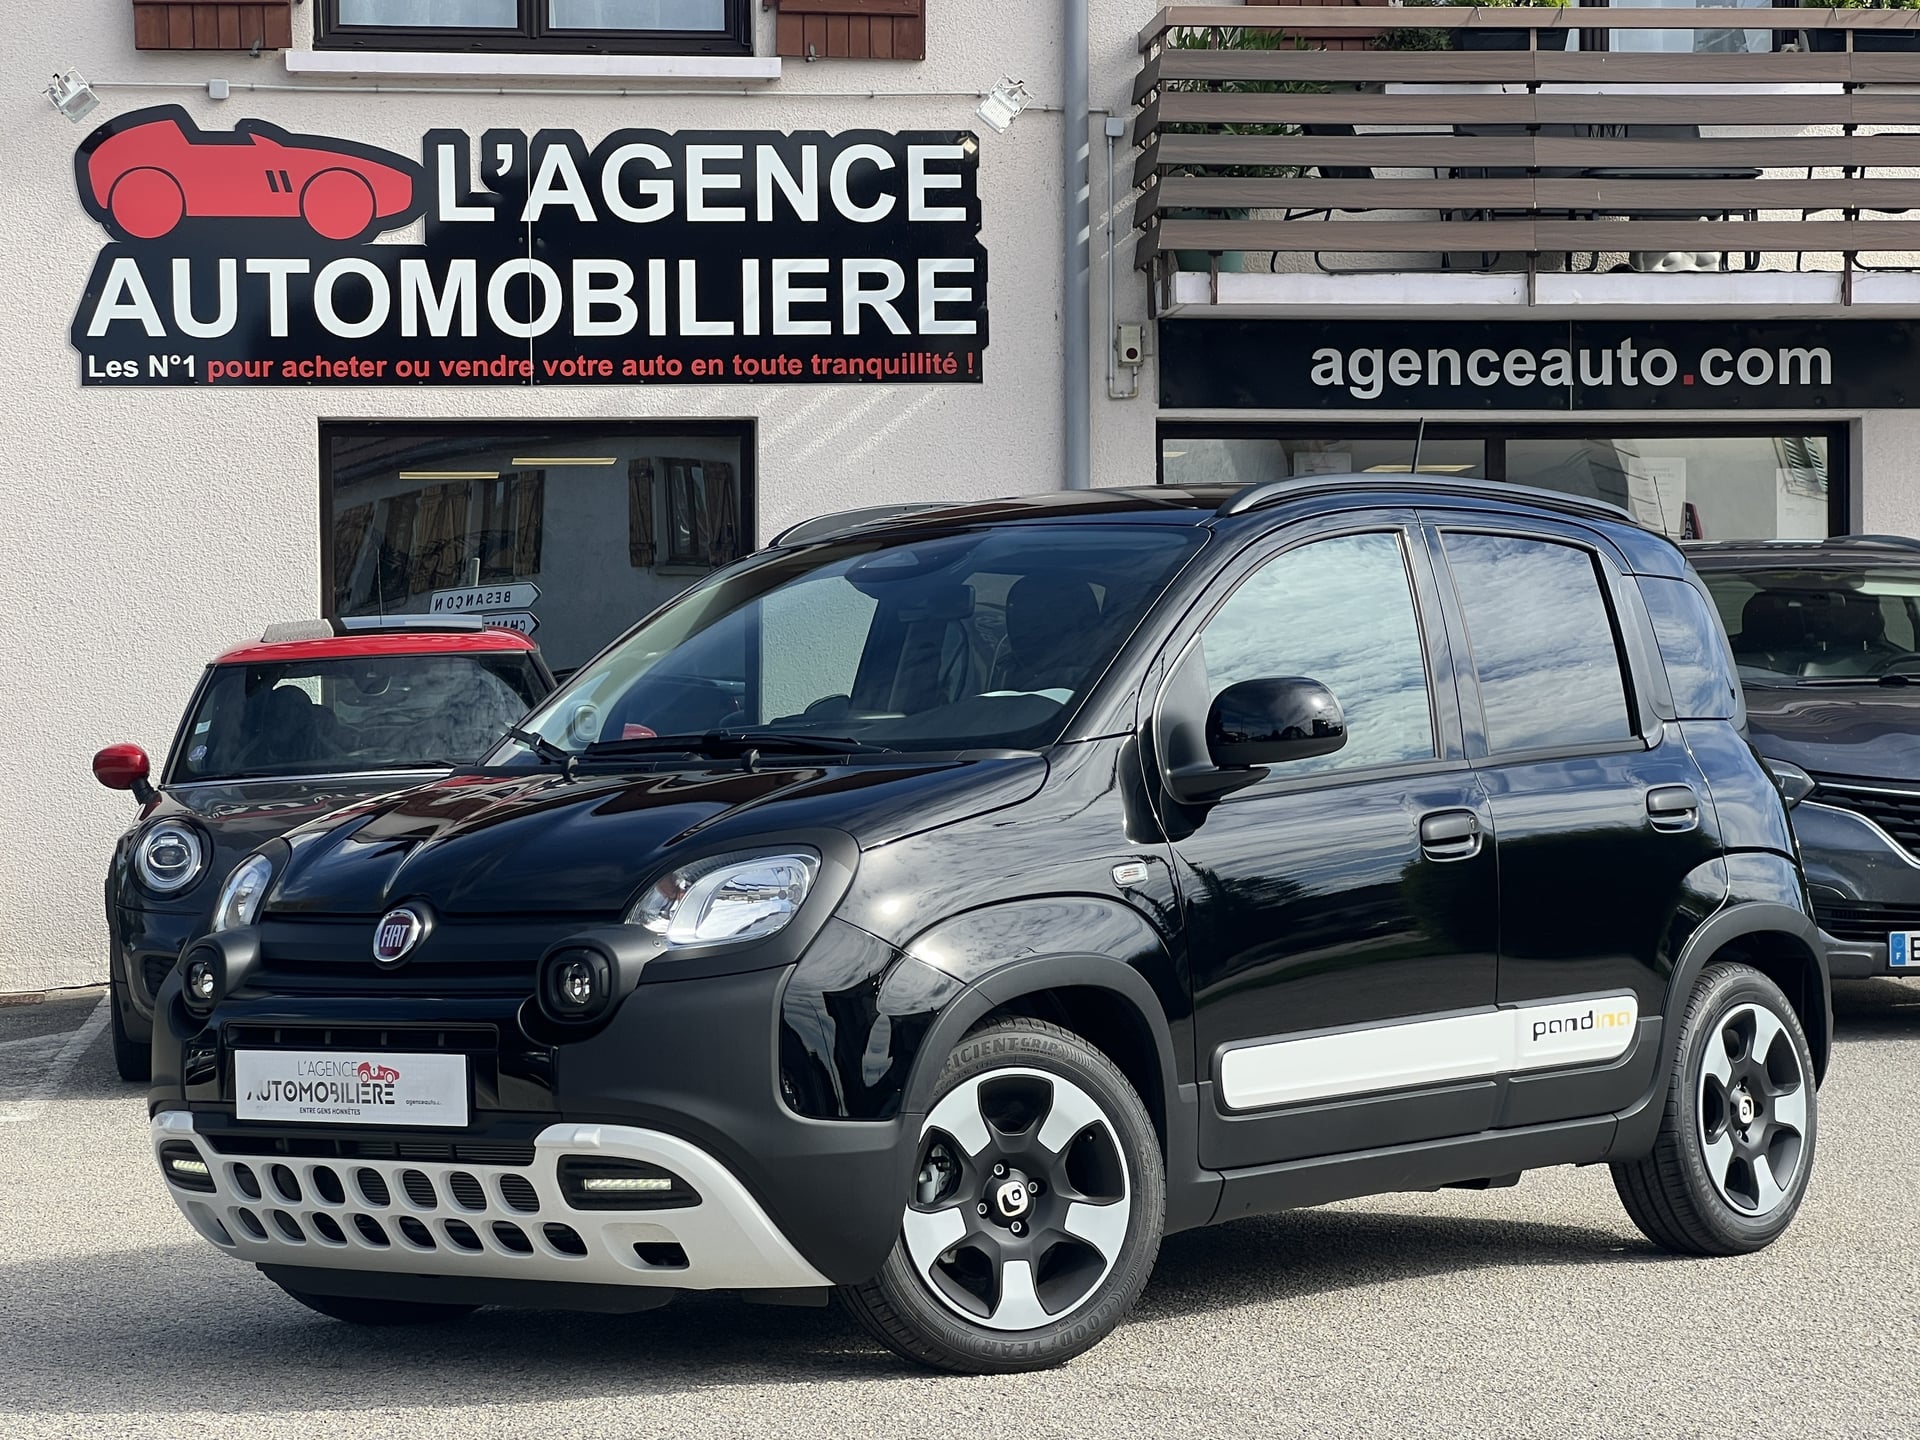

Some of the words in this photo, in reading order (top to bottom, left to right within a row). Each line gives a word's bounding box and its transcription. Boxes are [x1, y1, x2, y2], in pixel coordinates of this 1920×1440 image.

[437, 142, 967, 224] L'AGENCE
[86, 257, 978, 339] AUTOMOBILIERE
[88, 355, 139, 378] Les
[148, 355, 195, 378] N°1
[207, 360, 274, 382] pour
[282, 355, 388, 378] acheter
[395, 360, 431, 378] ou
[439, 355, 534, 378] vendre
[543, 356, 614, 377] votre
[622, 355, 683, 376] auto
[691, 359, 724, 376] en
[732, 355, 803, 376] toute
[811, 352, 958, 380] tranquillité
[1310, 337, 1832, 400] agenceauto.com
[380, 924, 410, 948] FIAT
[1895, 951, 1902, 961] F
[1533, 1009, 1631, 1042] pandina
[297, 1060, 358, 1078] L'AGENCE
[299, 1106, 316, 1115] ENTRE
